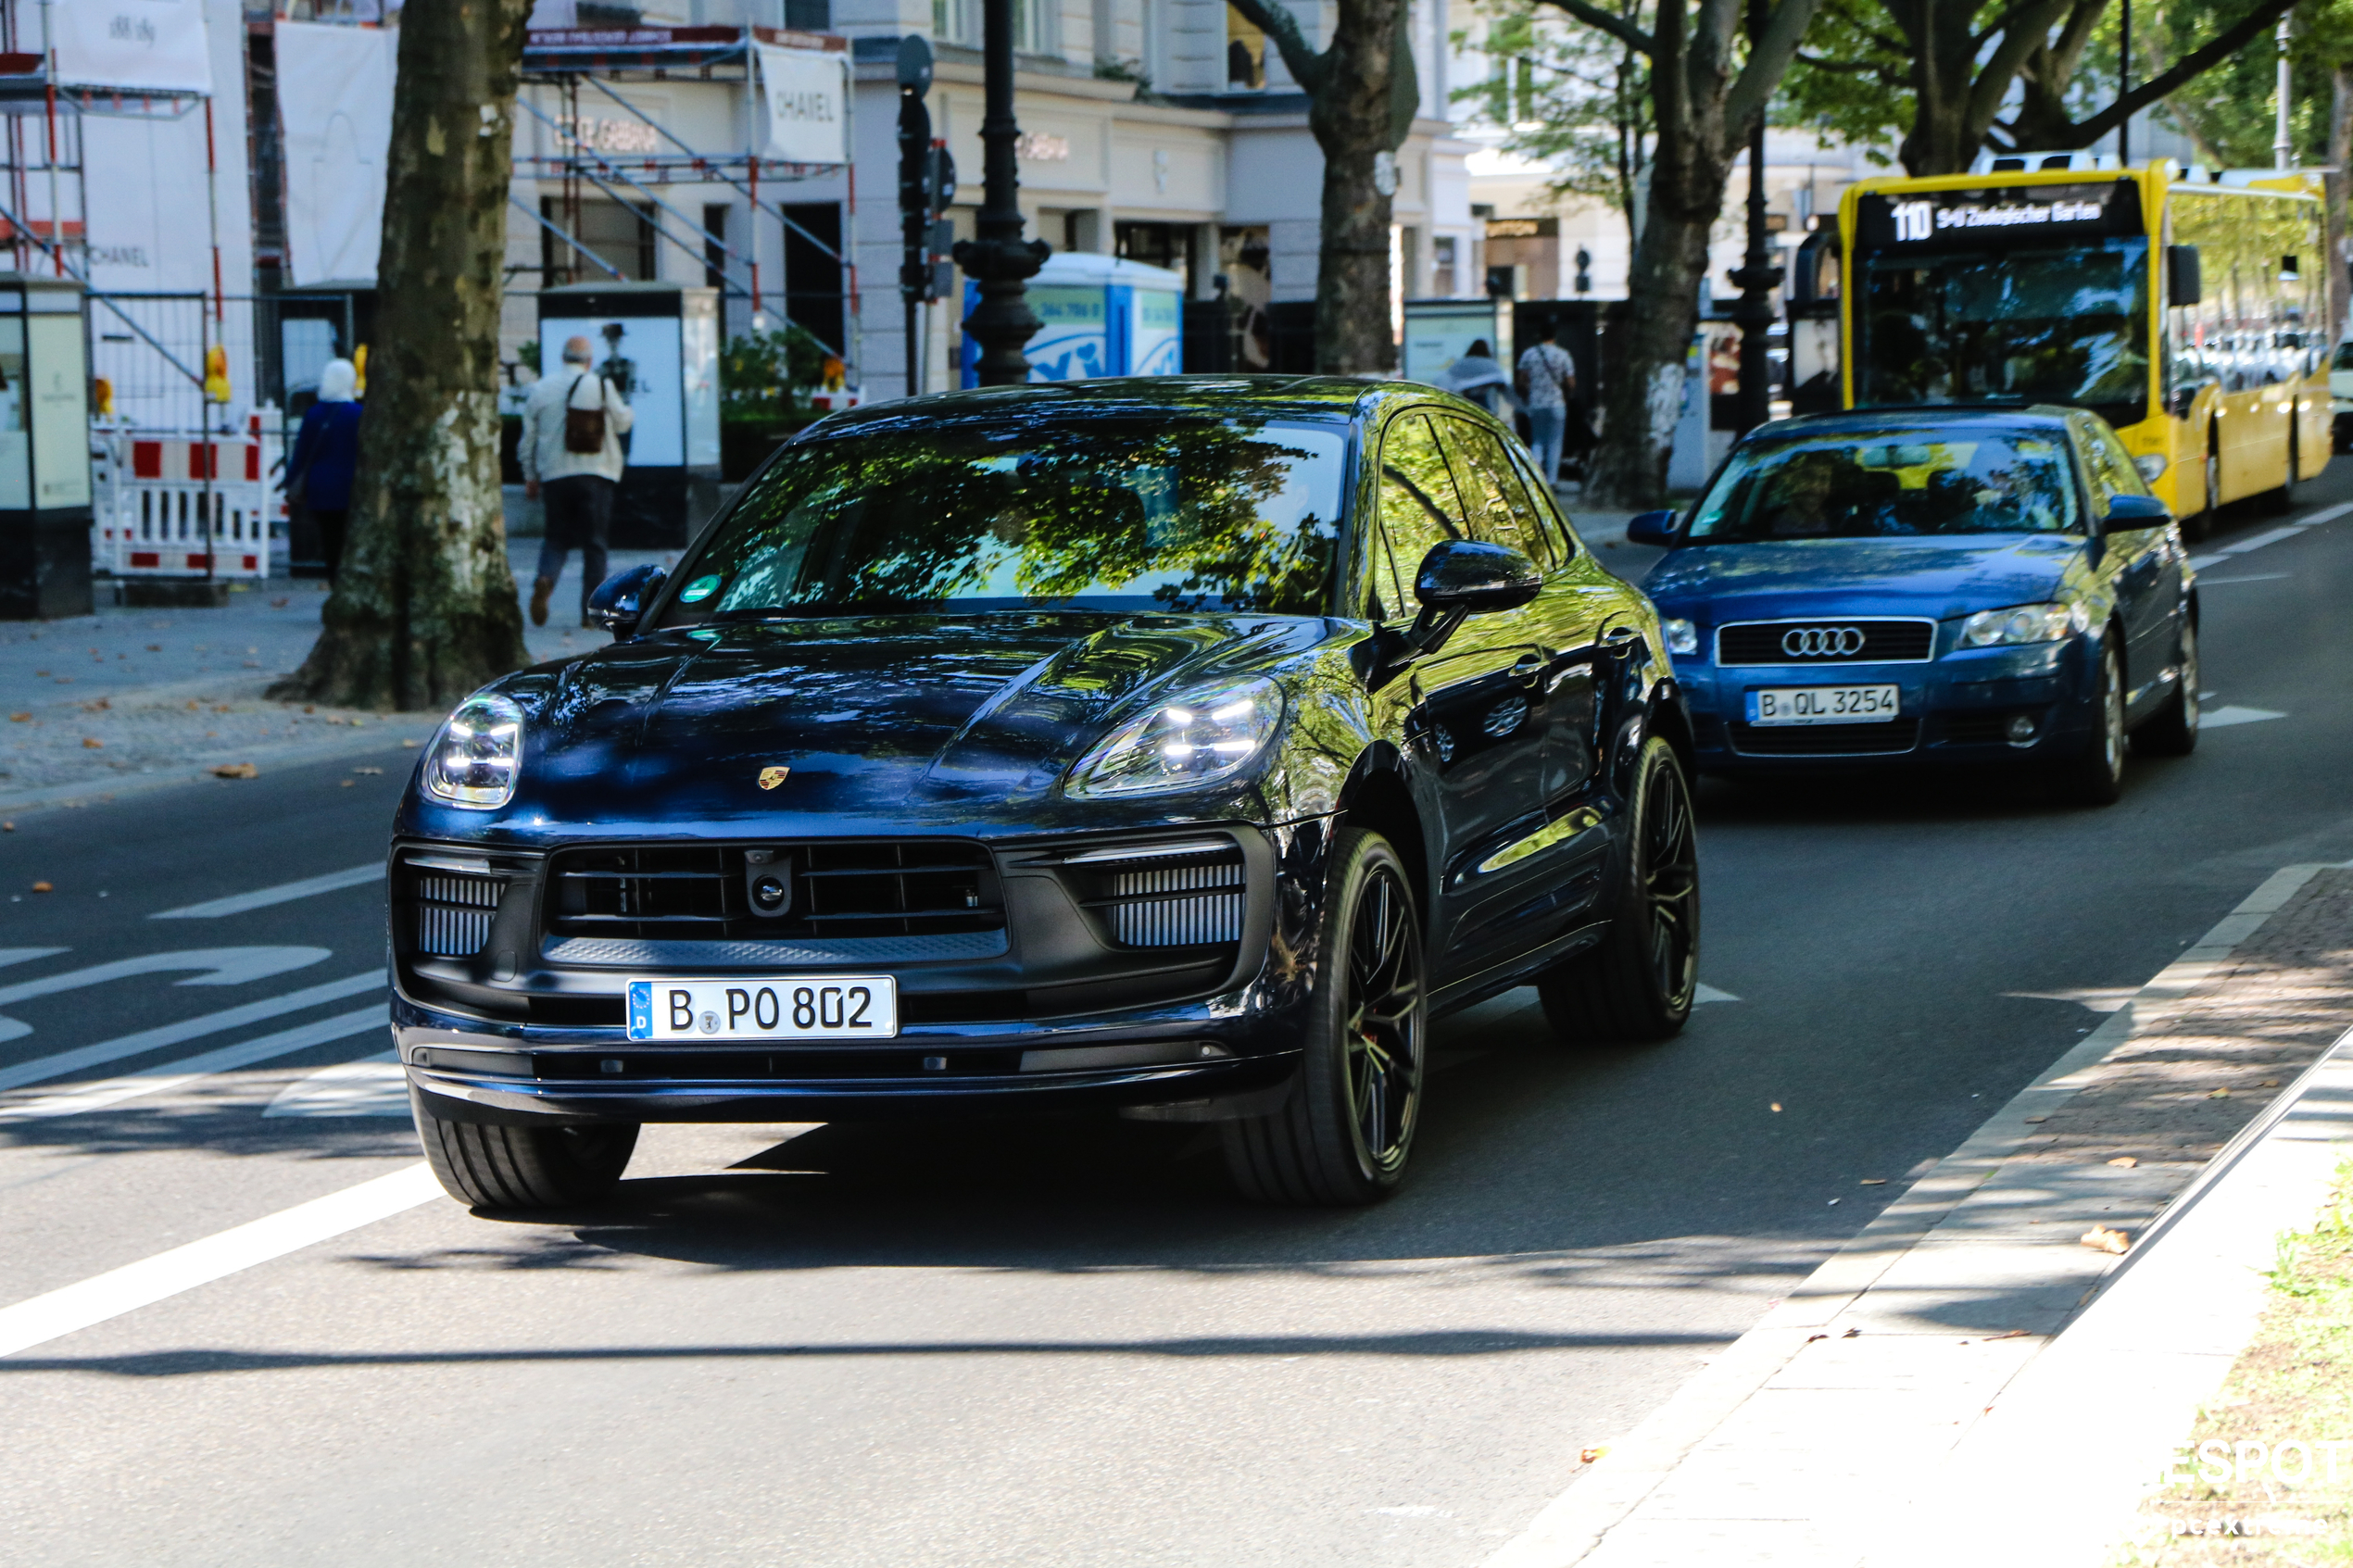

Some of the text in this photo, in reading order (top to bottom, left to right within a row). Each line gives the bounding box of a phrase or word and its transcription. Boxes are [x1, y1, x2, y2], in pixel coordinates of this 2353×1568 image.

[776, 91, 834, 122] CHANEL
[1891, 200, 1932, 242] 110
[1762, 689, 1894, 717] B QL 3254
[636, 1015, 647, 1029] D
[669, 985, 873, 1031] B PO 802
